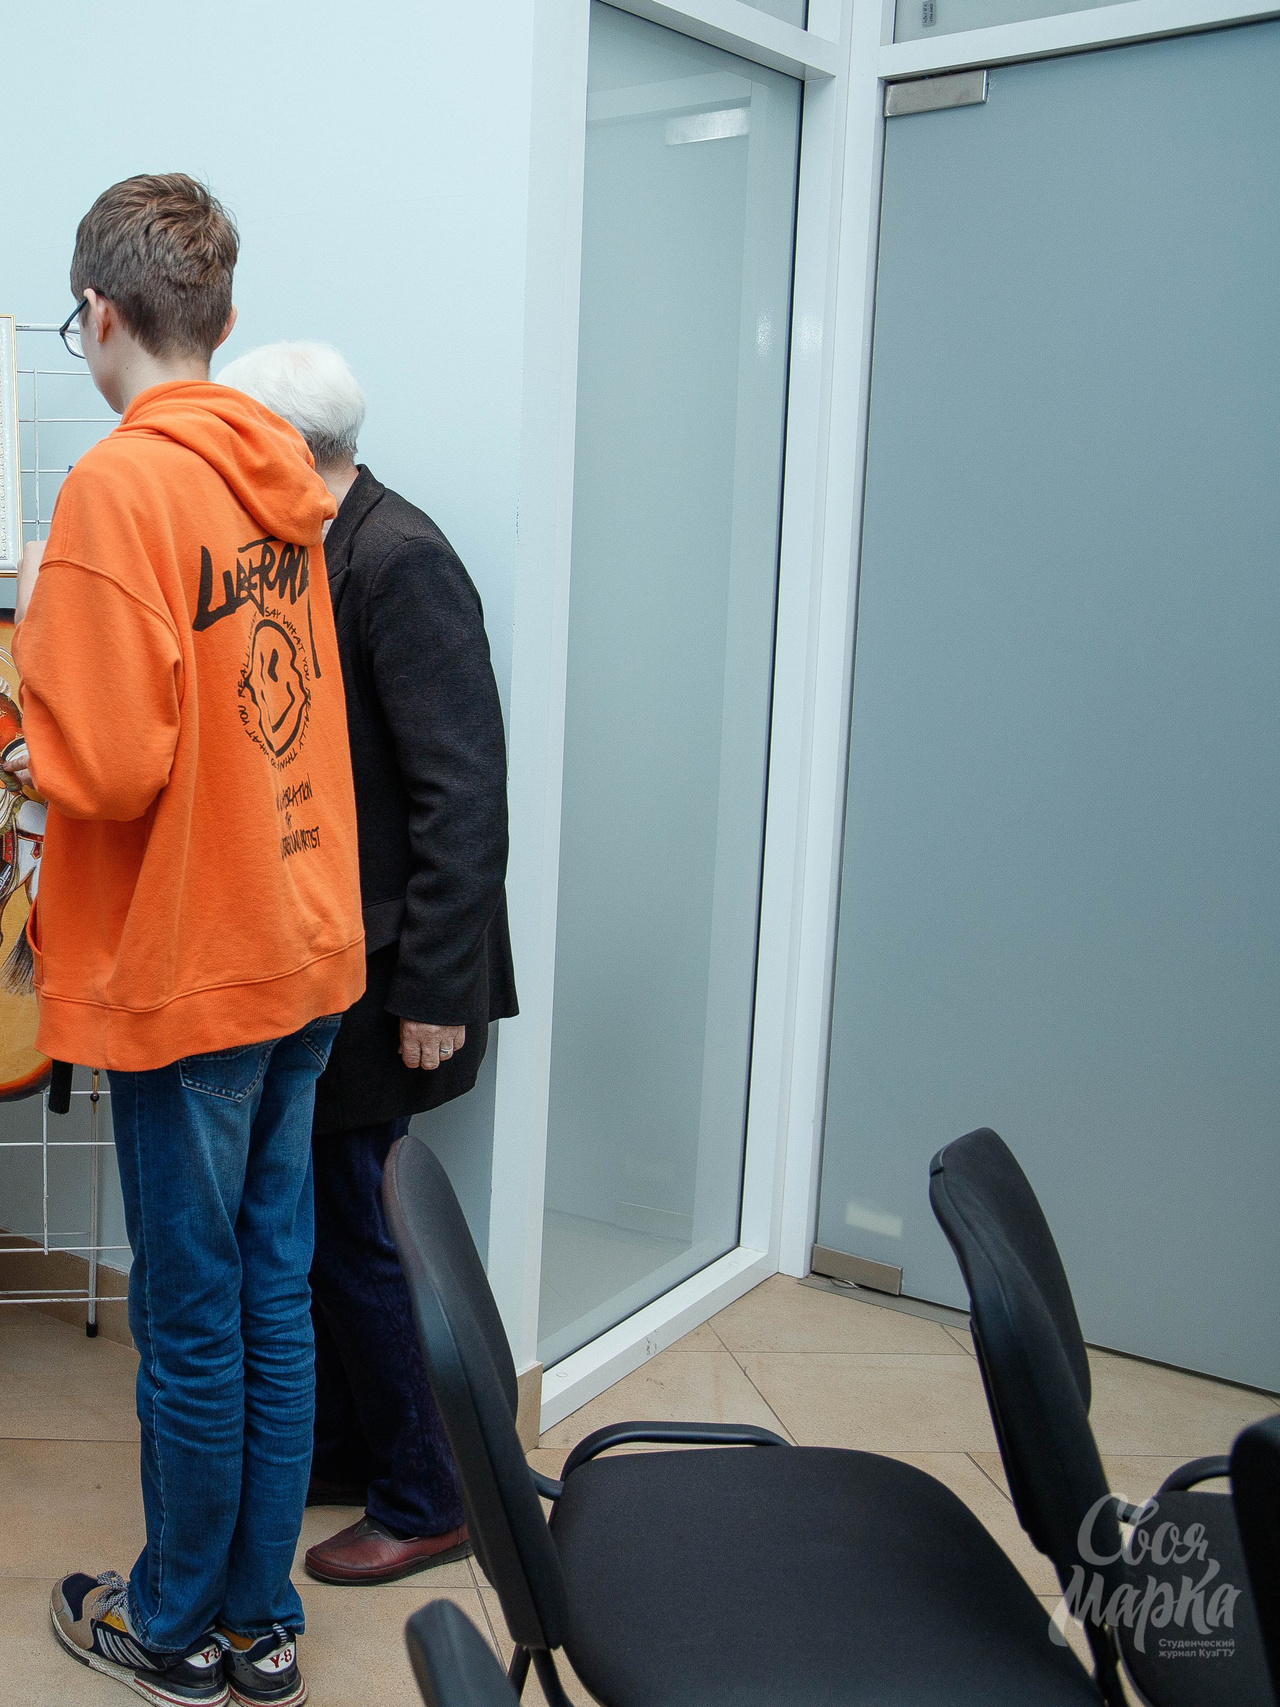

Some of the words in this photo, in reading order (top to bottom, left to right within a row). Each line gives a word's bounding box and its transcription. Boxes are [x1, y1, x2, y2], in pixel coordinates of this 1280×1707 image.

[265, 606, 281, 619] SAY
[283, 614, 305, 653] WHAT
[302, 656, 311, 682] YOU
[238, 705, 250, 726] YOU
[268, 1648, 293, 1669] Y-8
